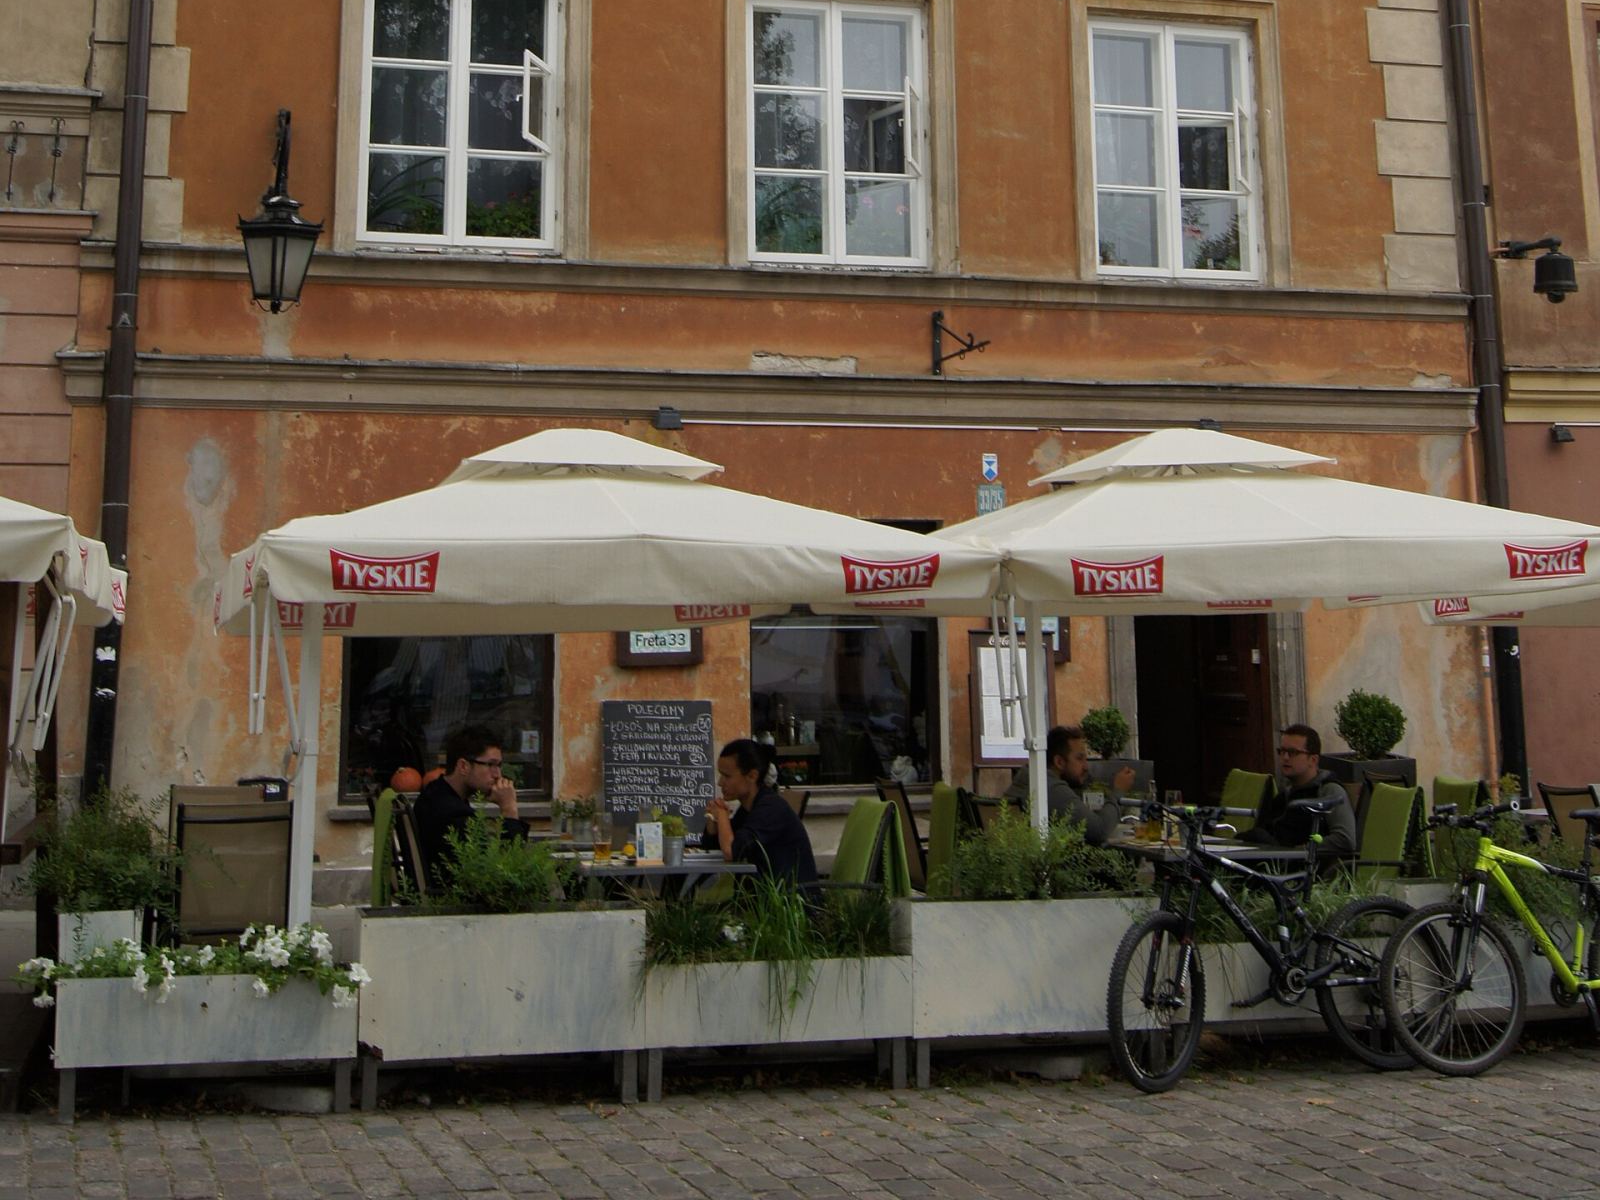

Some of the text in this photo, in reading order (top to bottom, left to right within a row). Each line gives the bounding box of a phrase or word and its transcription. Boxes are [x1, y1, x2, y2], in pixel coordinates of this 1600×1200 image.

[1512, 547, 1581, 575] TYSKIE
[338, 558, 432, 589] TYSKIE
[849, 561, 932, 590] TYSKIE
[1078, 563, 1160, 592] TYSKIE
[635, 633, 686, 647] Freta 33
[627, 704, 686, 716] POLECAMY
[646, 722, 660, 732] NA
[612, 732, 619, 740] Z
[613, 752, 619, 761] Z
